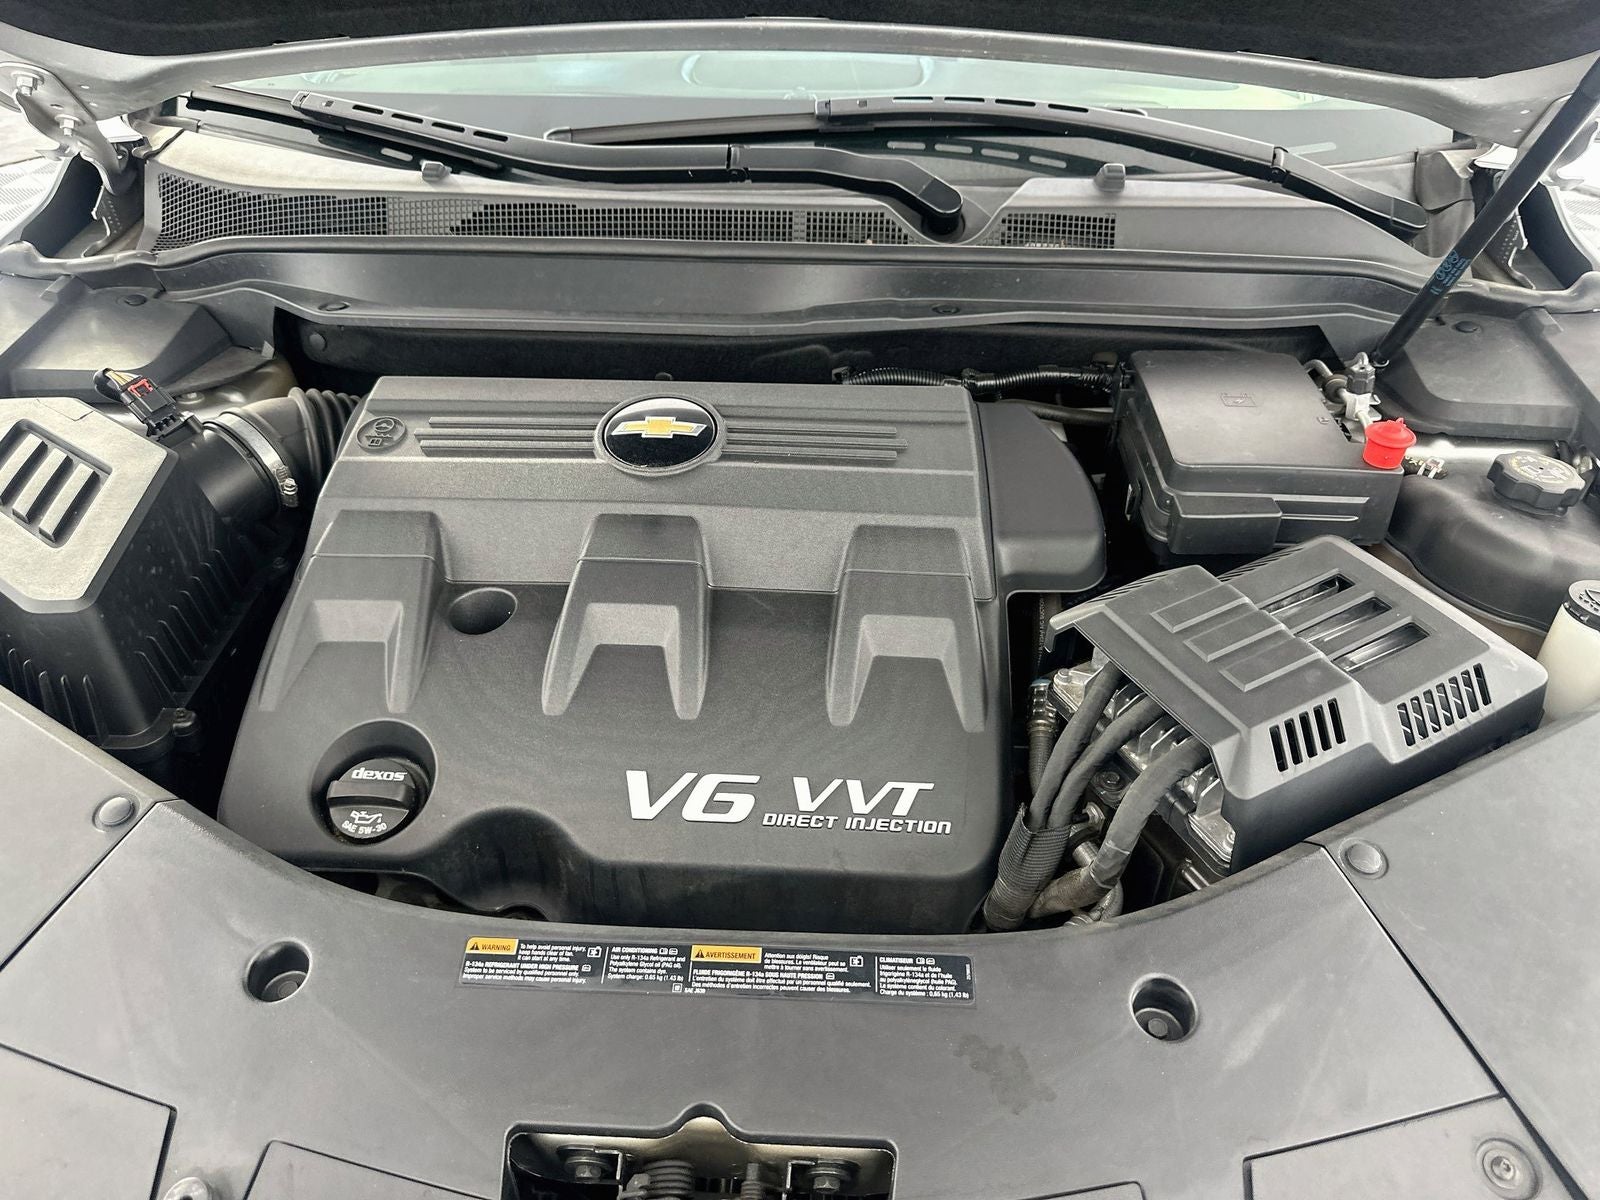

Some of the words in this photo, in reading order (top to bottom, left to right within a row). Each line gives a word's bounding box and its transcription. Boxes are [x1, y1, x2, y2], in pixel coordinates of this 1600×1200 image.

[352, 767, 407, 781] dexos
[626, 770, 760, 823] V6
[793, 776, 935, 816] VVT
[341, 820, 357, 833] SAE
[358, 822, 387, 835] 5W-30
[762, 813, 838, 829] DIRECT
[845, 817, 951, 834] INJECTION
